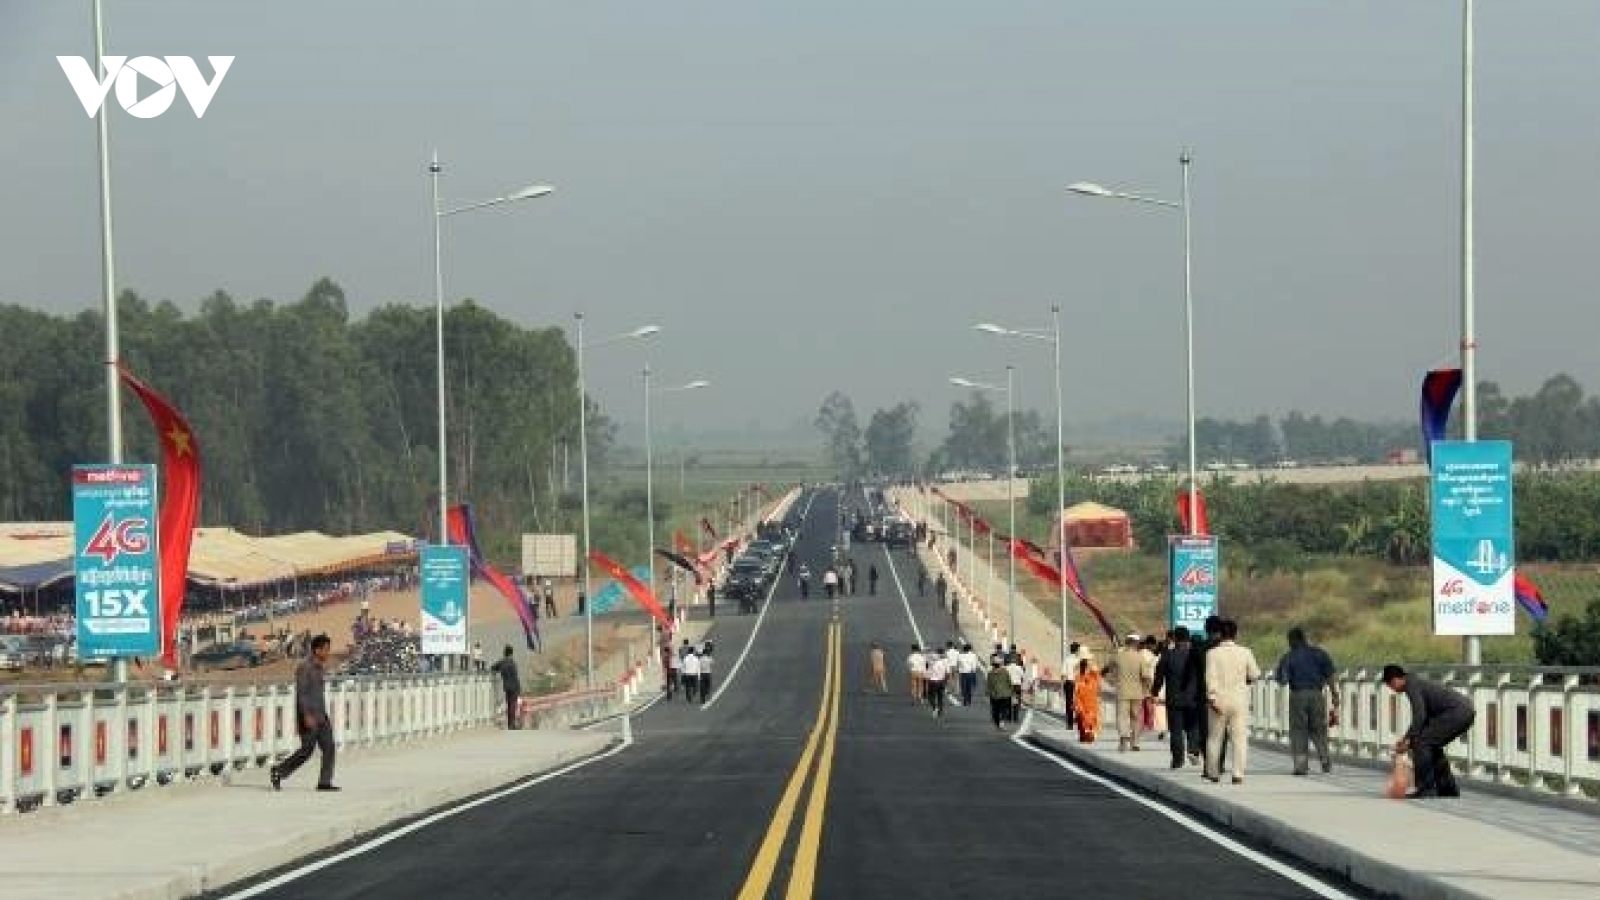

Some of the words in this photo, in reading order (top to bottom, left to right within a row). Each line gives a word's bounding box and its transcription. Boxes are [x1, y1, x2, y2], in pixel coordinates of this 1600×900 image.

[81, 511, 150, 566] 4G
[1440, 578, 1463, 597] 4G
[84, 589, 148, 617] 15X
